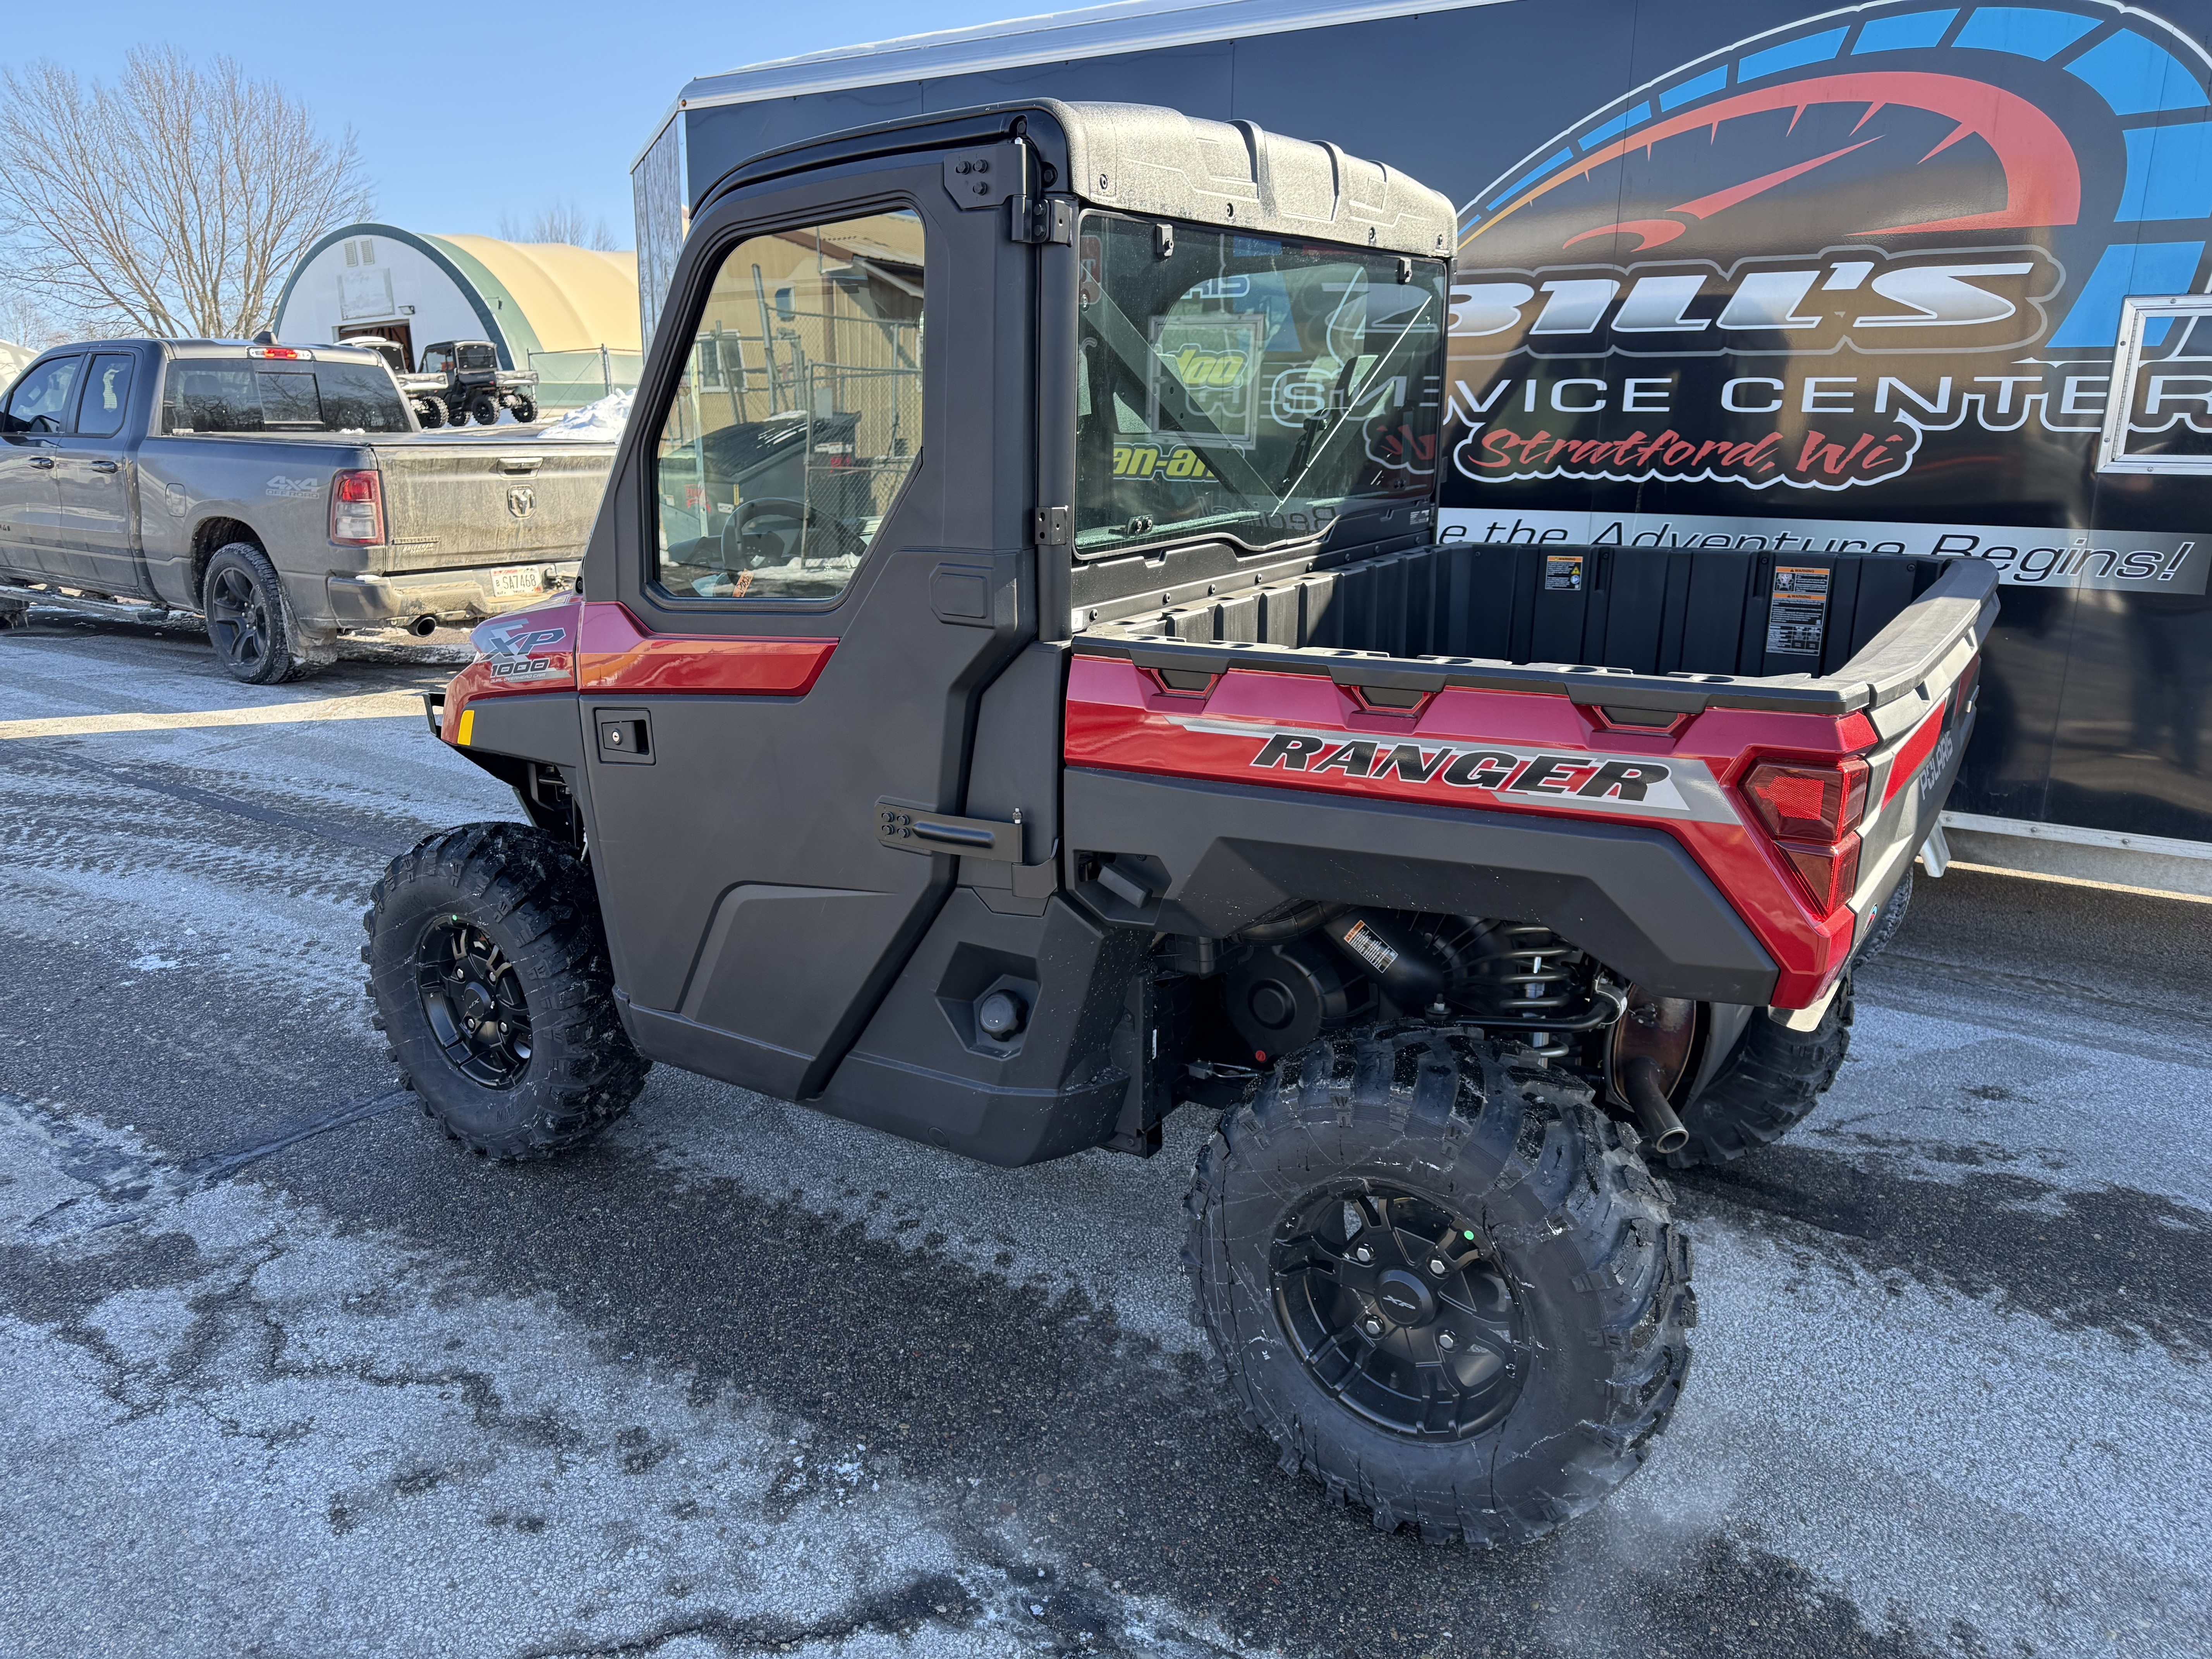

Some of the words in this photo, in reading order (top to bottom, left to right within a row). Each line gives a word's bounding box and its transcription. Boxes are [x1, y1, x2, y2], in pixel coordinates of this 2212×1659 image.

[1468, 428, 1783, 473] Stratford,
[1796, 430, 1903, 474] Wi
[1484, 518, 1568, 544] the
[1930, 533, 2195, 582] Begins!
[503, 574, 536, 589] SA7468
[479, 627, 566, 663] XP
[490, 658, 550, 678] 1000
[504, 673, 532, 682] OVERHEAD
[1249, 733, 1672, 801] RANGER
[1919, 731, 1953, 800] POLARIS
[1348, 922, 1364, 939] WARNING
[1382, 1295, 1416, 1310] XP
